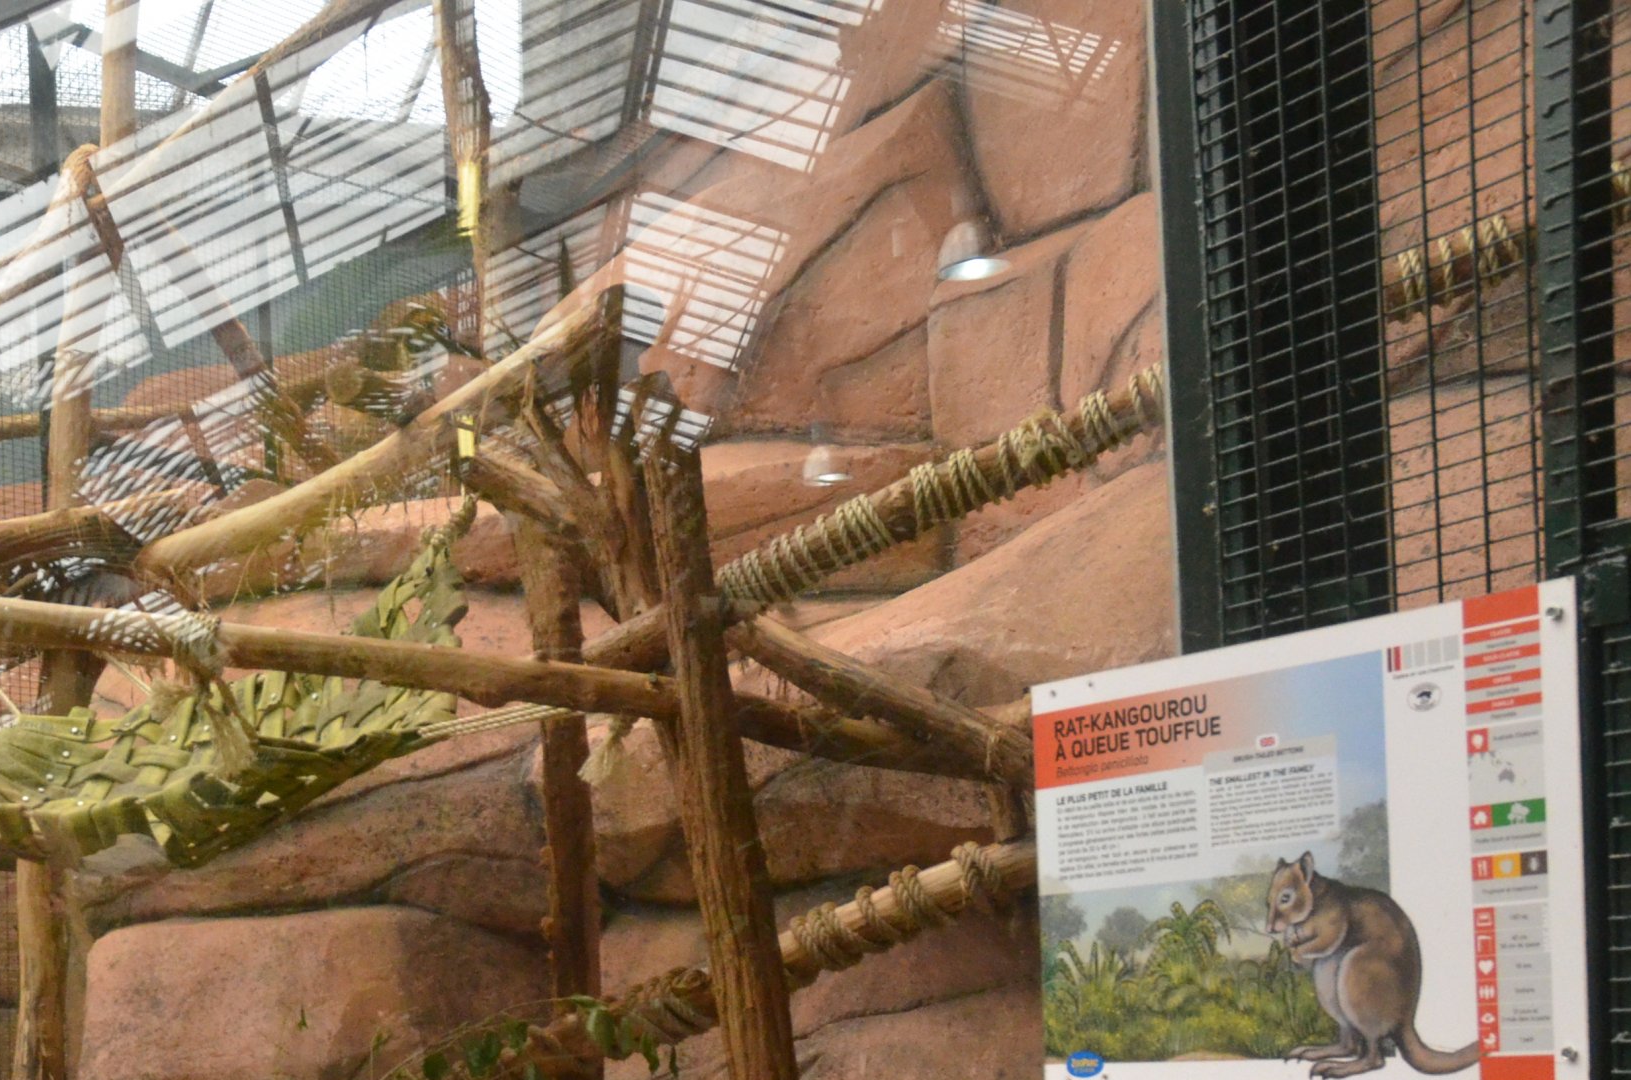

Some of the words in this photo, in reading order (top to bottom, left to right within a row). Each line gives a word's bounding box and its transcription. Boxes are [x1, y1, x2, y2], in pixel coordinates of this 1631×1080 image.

[1054, 694, 1207, 738] RAT-KANGOUROU
[1055, 739, 1067, 762] À
[1071, 732, 1130, 758] QUEUE
[1135, 716, 1221, 748] TOUFFUE
[1056, 795, 1066, 806] LE
[1066, 793, 1087, 805] PLUS
[1088, 789, 1110, 801] PETIT
[1111, 788, 1121, 798] DE
[1123, 786, 1133, 797] LA
[1135, 781, 1168, 795] FAMILLE
